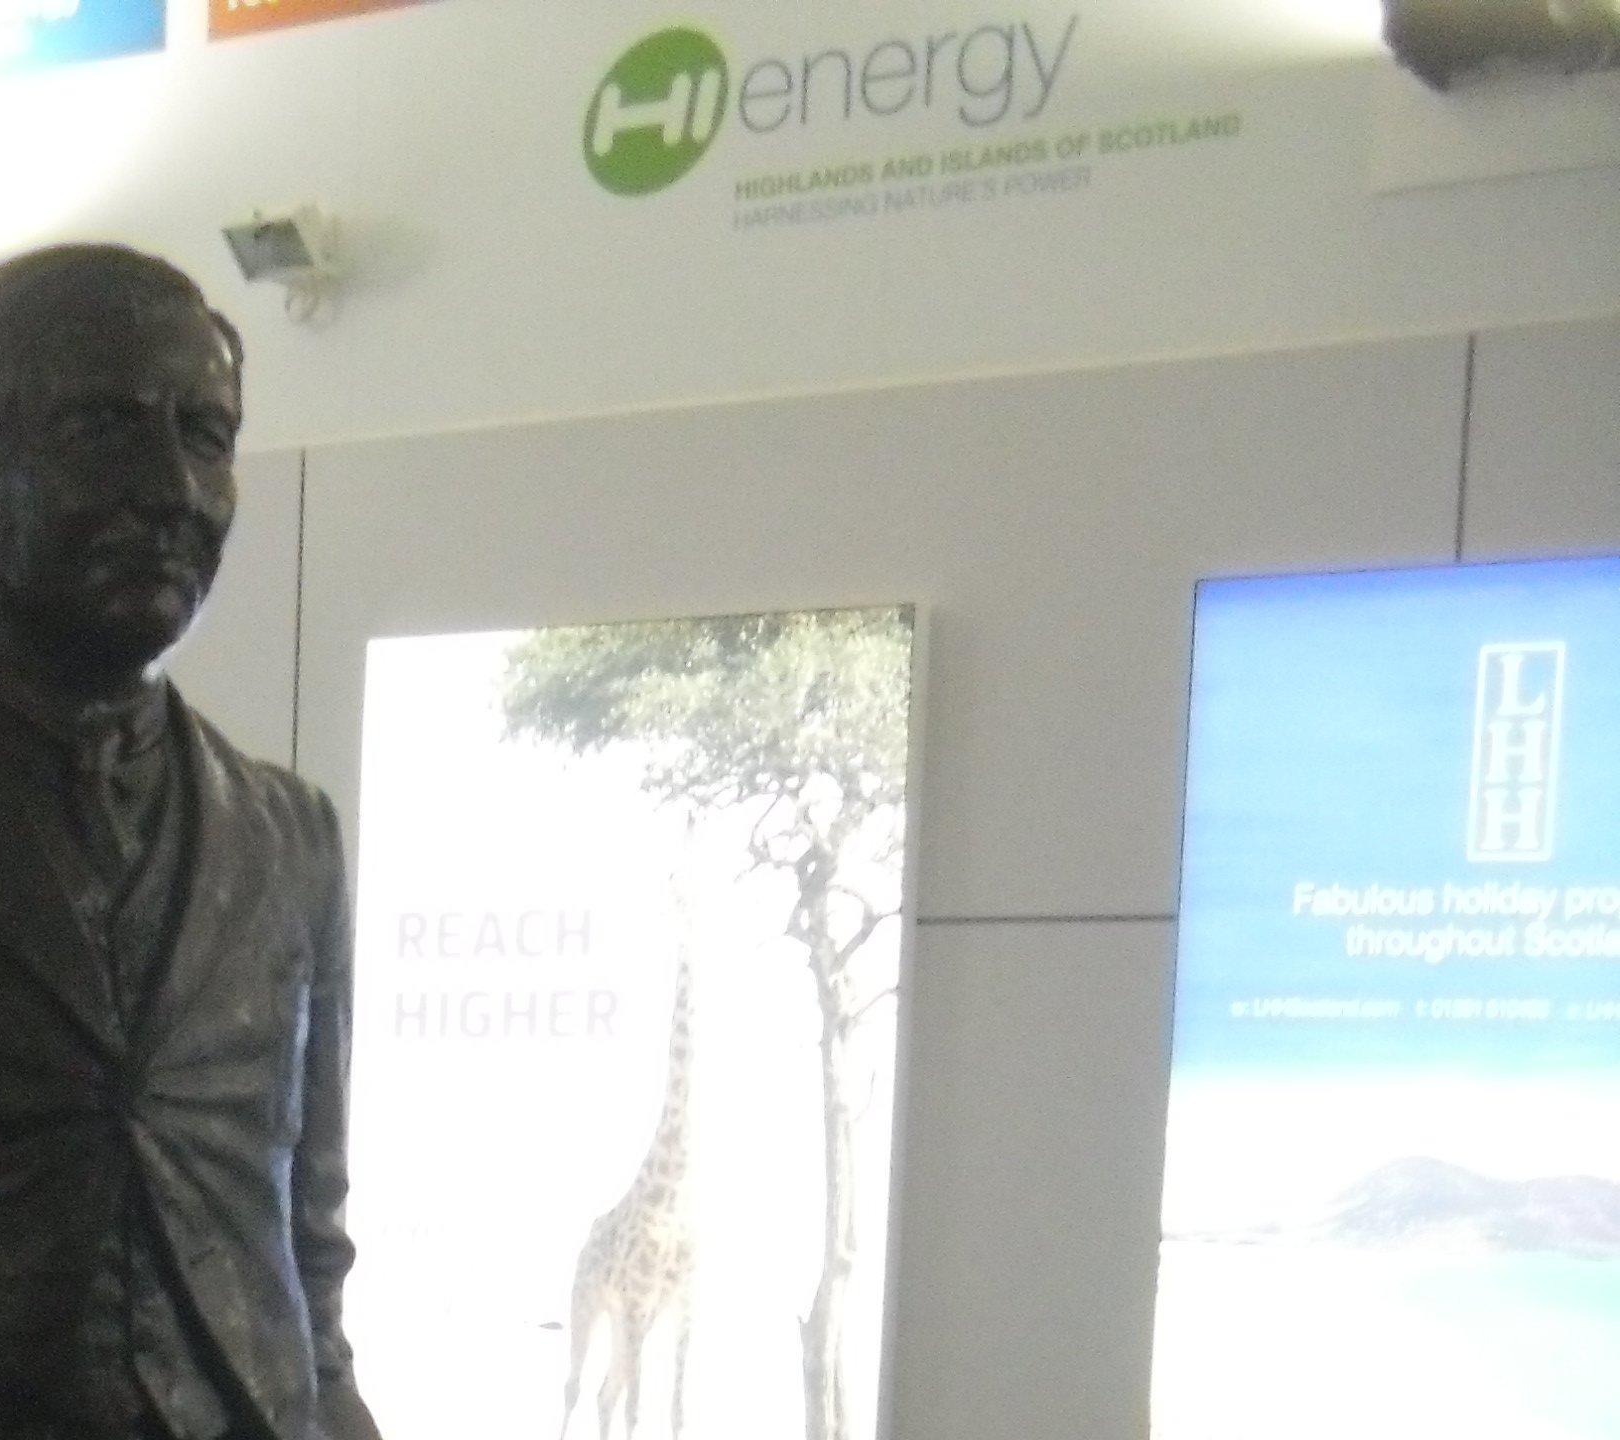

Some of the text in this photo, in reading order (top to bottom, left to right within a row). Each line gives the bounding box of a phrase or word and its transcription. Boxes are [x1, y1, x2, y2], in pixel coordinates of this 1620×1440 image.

[738, 14, 1078, 133] energy
[734, 112, 1243, 201] HIGHLANDS AND ISLANDS OF SCOTLAND
[1481, 652, 1548, 852] LHH
[1292, 881, 1435, 918] Fabulous
[1442, 880, 1558, 925] holiday
[396, 909, 591, 958] REACH
[1345, 922, 1516, 965] throughout
[394, 988, 620, 1038] HIGHER
